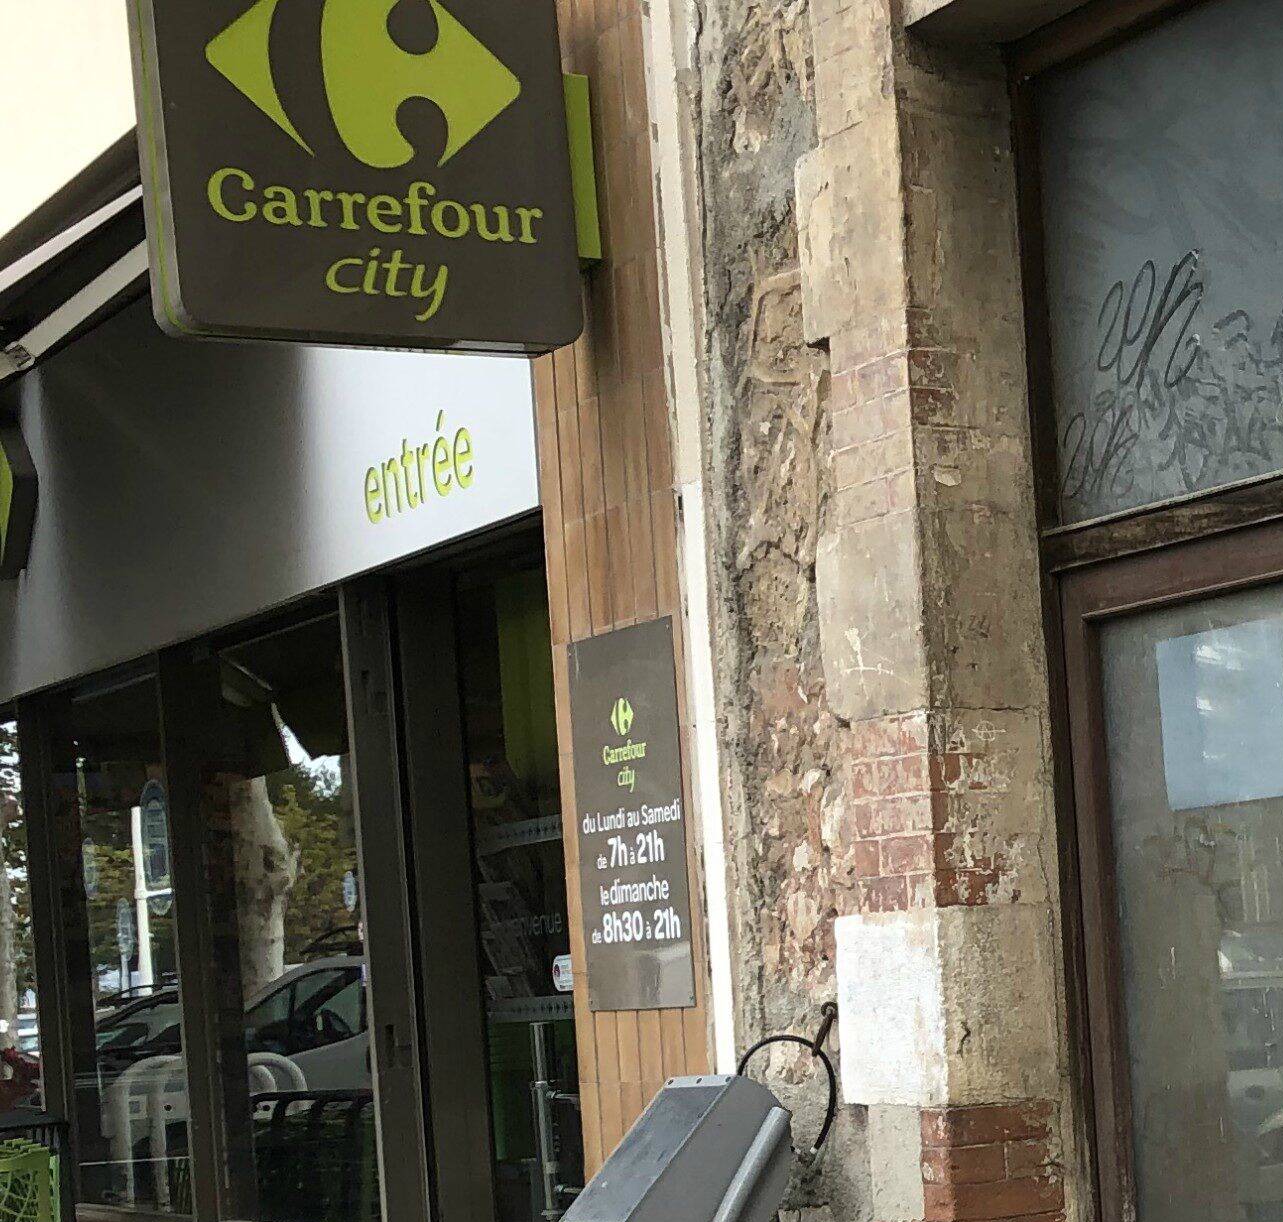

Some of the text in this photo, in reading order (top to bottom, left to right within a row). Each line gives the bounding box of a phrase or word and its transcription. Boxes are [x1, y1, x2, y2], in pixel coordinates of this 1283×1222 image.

[206, 167, 542, 244] Carrefour
[325, 247, 449, 321] city
[363, 409, 475, 524] entrée
[602, 739, 647, 765] Carrefour
[617, 766, 635, 793] city
[582, 798, 681, 834] du Lundi au Samedi
[597, 829, 665, 869] de 7h à 21h
[600, 874, 669, 906] le dimanche
[592, 906, 682, 944] de 8h30 à 21h
